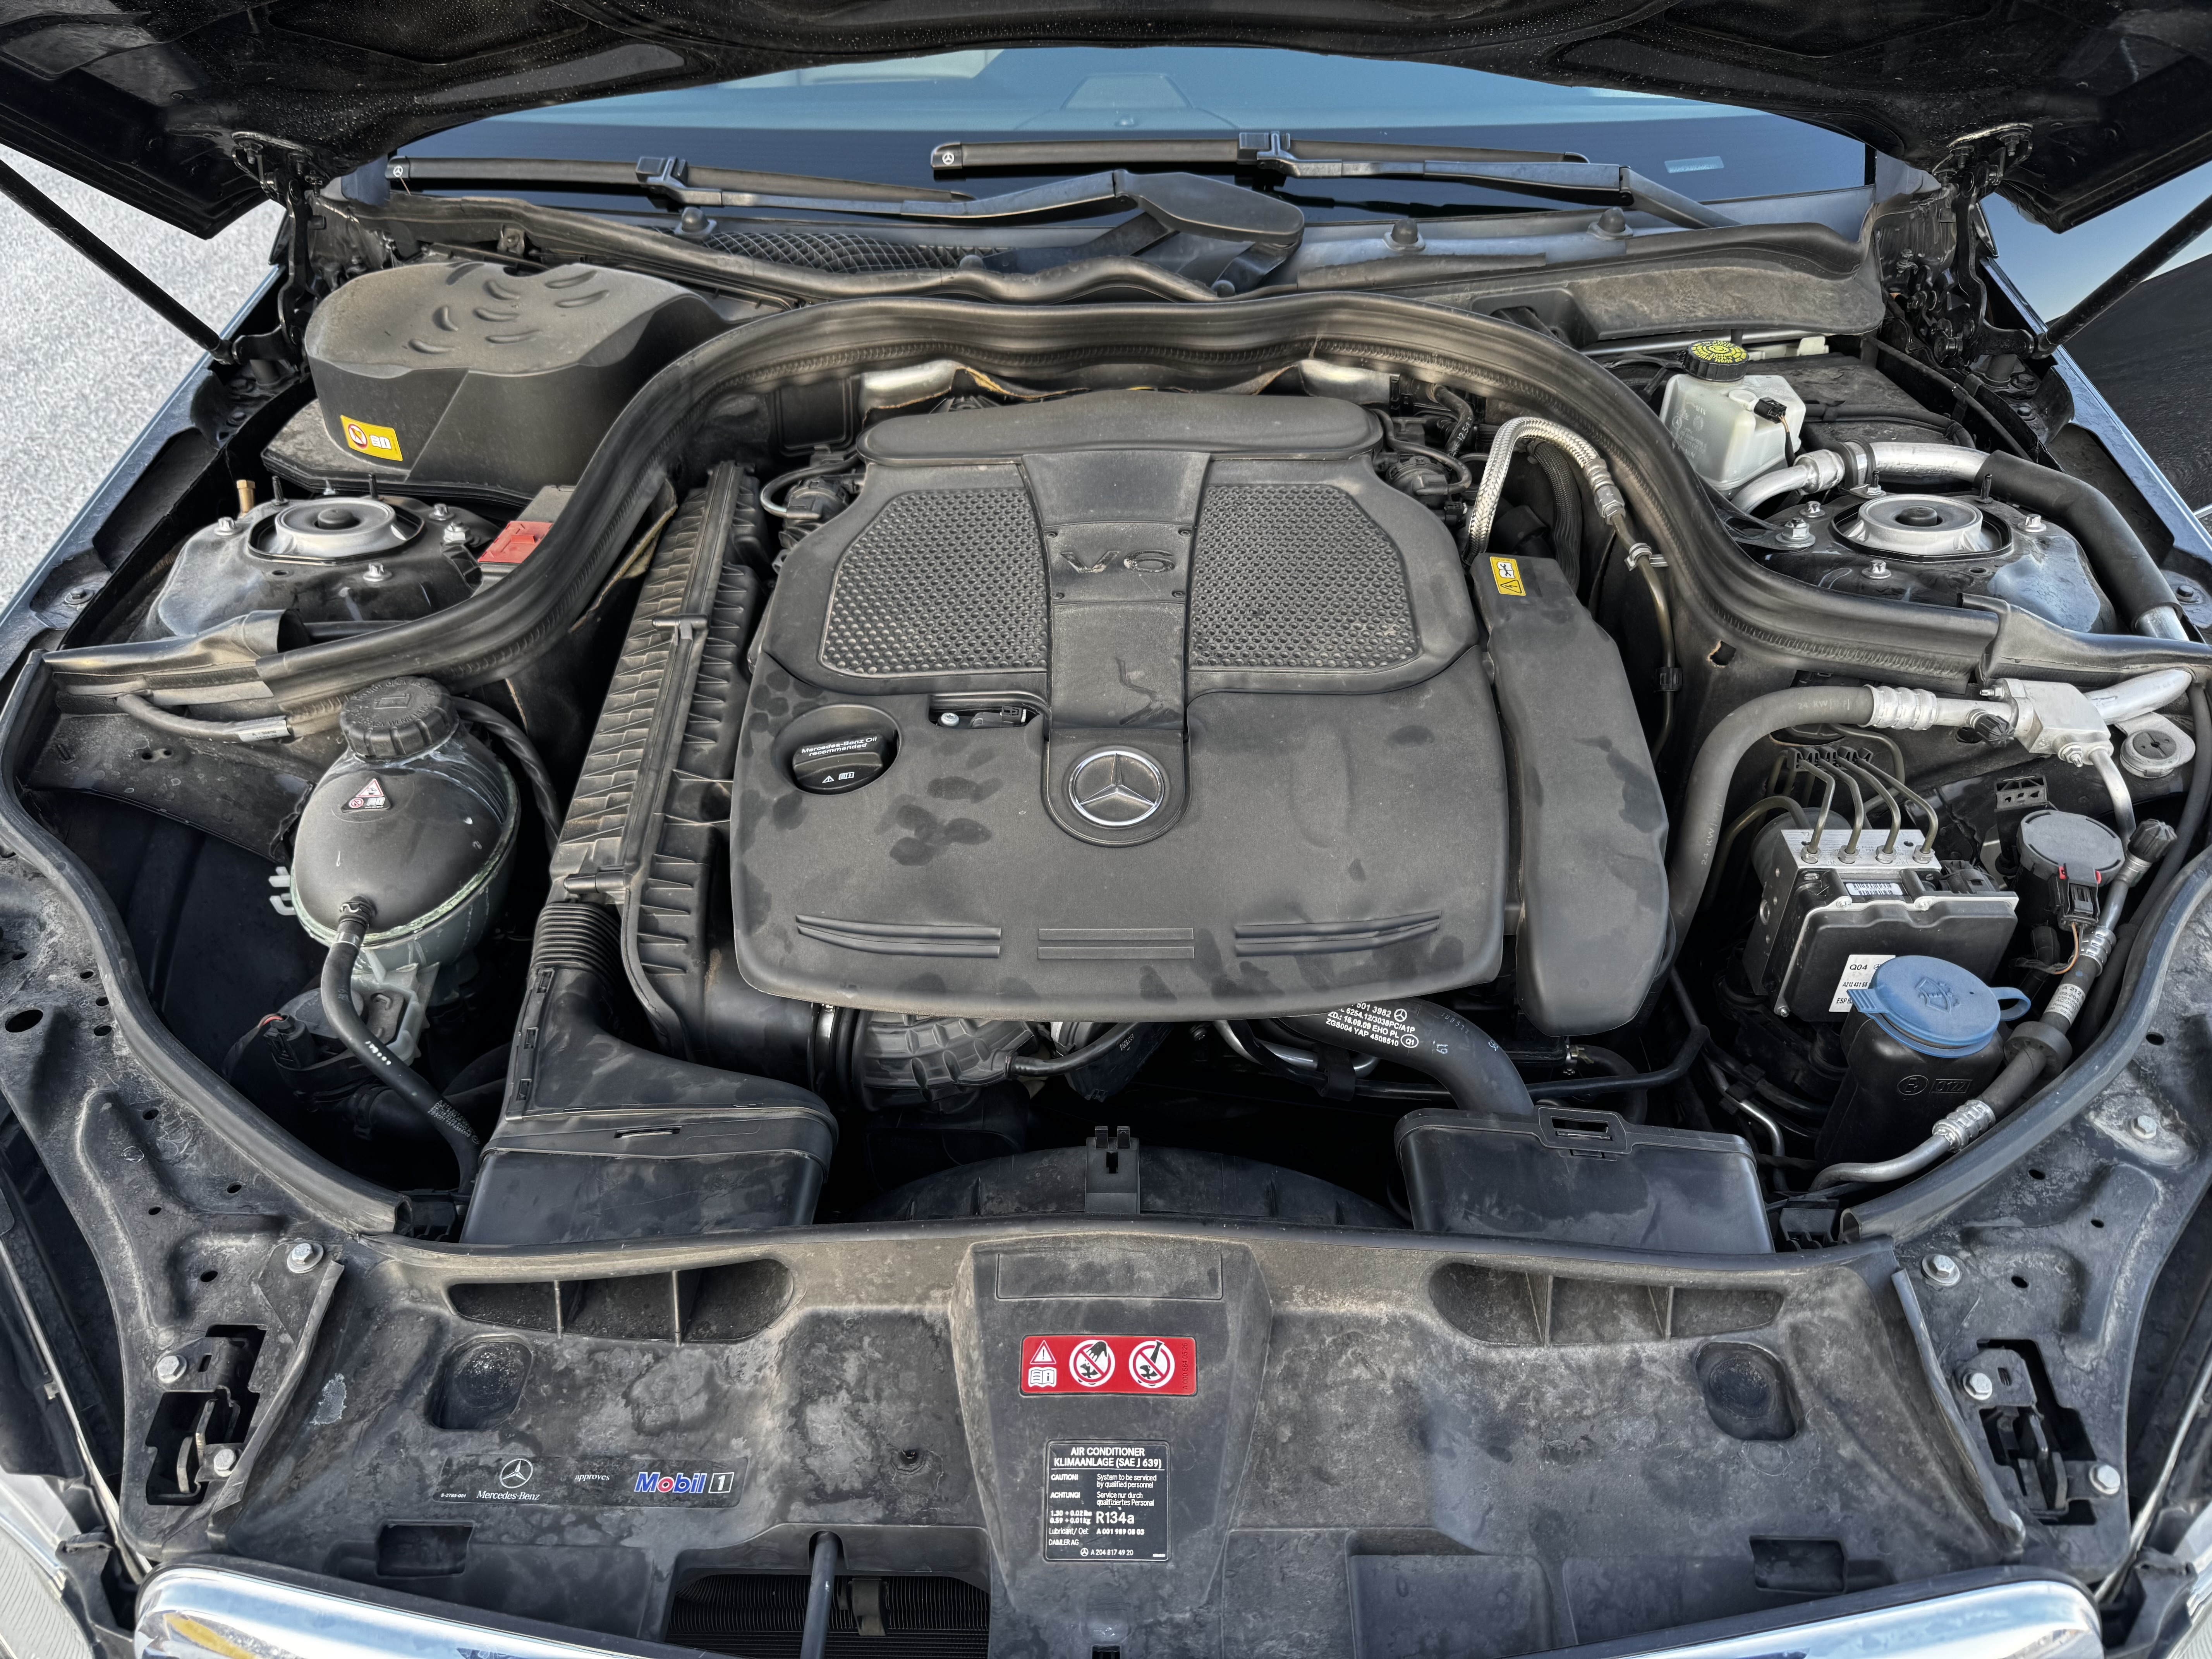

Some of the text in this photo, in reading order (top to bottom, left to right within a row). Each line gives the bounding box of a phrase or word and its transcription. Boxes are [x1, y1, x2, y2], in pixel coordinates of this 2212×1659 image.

[1060, 550, 1176, 574] V6
[801, 739, 864, 754] Mercedes-Benz
[809, 743, 867, 756] recommended
[1372, 1006, 1392, 1018] 3982
[1354, 1027, 1369, 1037] YAP
[1372, 1025, 1389, 1035] EHO
[1389, 1030, 1400, 1039] PL
[1070, 1447, 1145, 1456] AIR CONDITIONER
[1054, 1458, 1162, 1469] KLIMAANLAGE (SAE J 639)
[574, 1473, 610, 1482] approves
[634, 1471, 708, 1494] Mobil
[1097, 1474, 1117, 1482] System
[1097, 1481, 1104, 1489] by
[1105, 1481, 1127, 1489] qualified
[476, 1491, 541, 1501] Mercedes-Benz
[1096, 1499, 1130, 1507] qualifiziertes
[1083, 1517, 1091, 1525] kg
[1096, 1511, 1135, 1524] R134a
